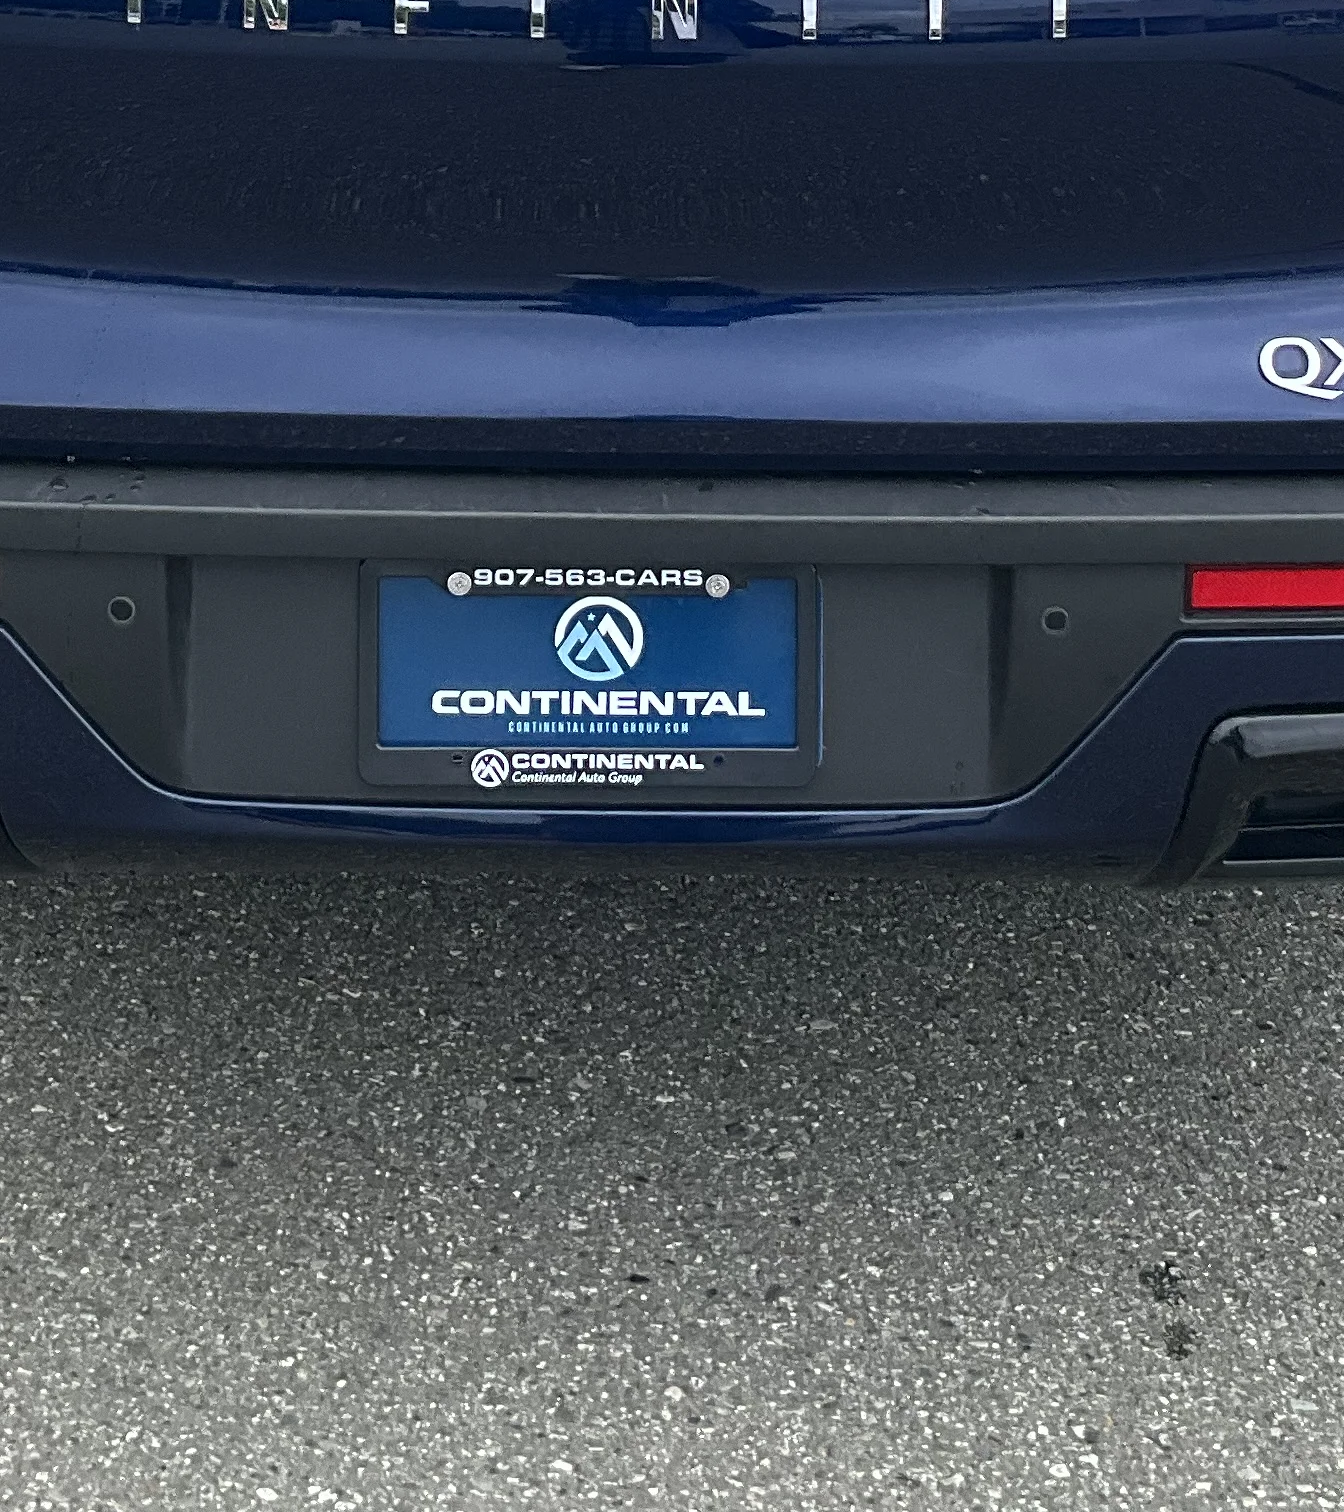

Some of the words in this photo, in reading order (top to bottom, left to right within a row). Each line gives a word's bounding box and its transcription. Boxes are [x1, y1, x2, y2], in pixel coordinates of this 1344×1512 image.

[473, 568, 704, 587] 907-563-CARS
[431, 689, 766, 717] CONTINENTAL
[511, 753, 705, 770] CONTINENTAL
[511, 770, 577, 783] Continental
[578, 771, 606, 784] Auto
[608, 771, 644, 787] Group
